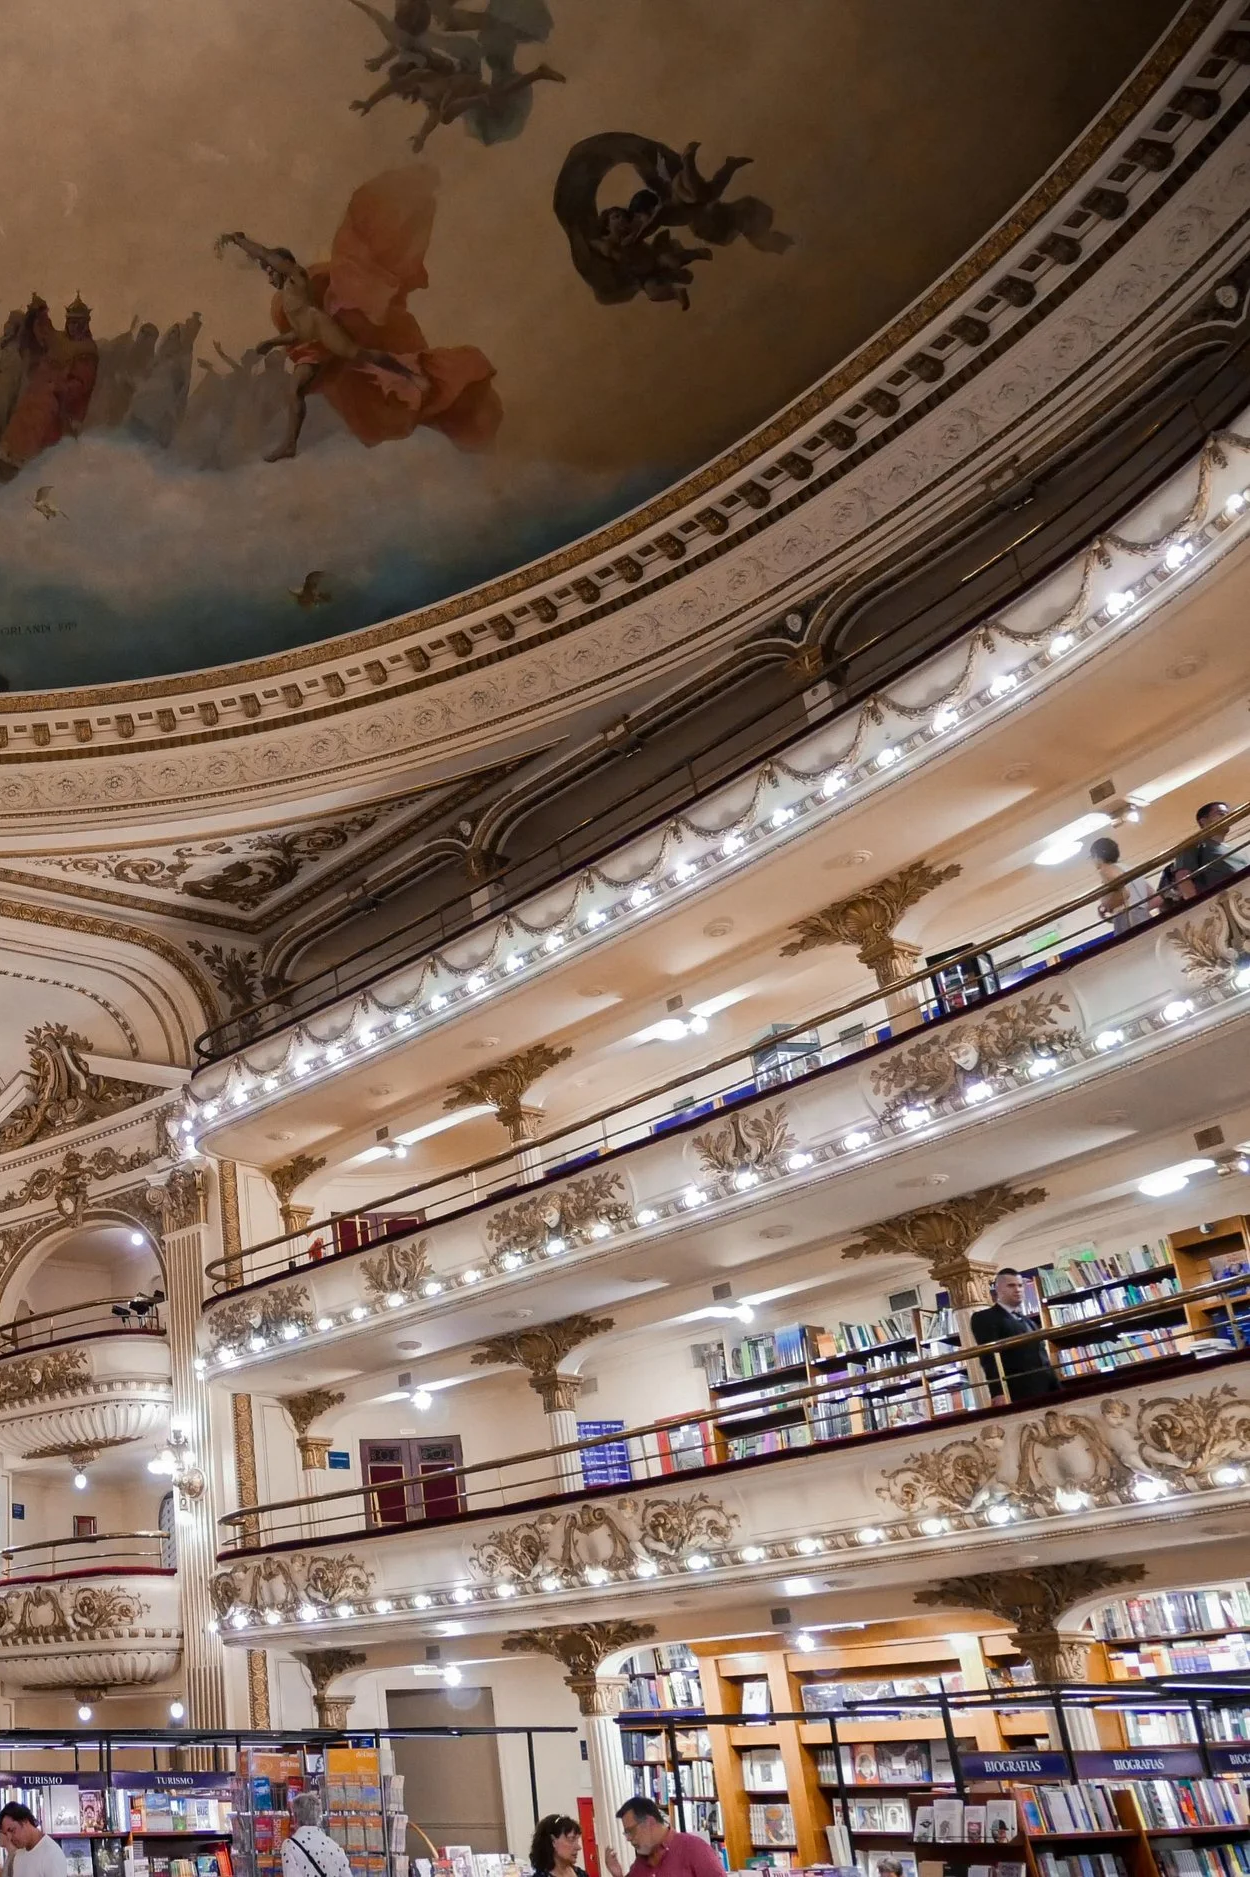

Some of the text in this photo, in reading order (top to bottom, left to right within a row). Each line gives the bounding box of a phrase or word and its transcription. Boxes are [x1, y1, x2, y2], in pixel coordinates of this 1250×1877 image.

[984, 1760, 1041, 1773] BIOGRAFIAS
[1113, 1758, 1165, 1770] BIOGRAFIAS
[21, 1775, 63, 1785] TURISMO
[156, 1776, 194, 1785] TURISMO
